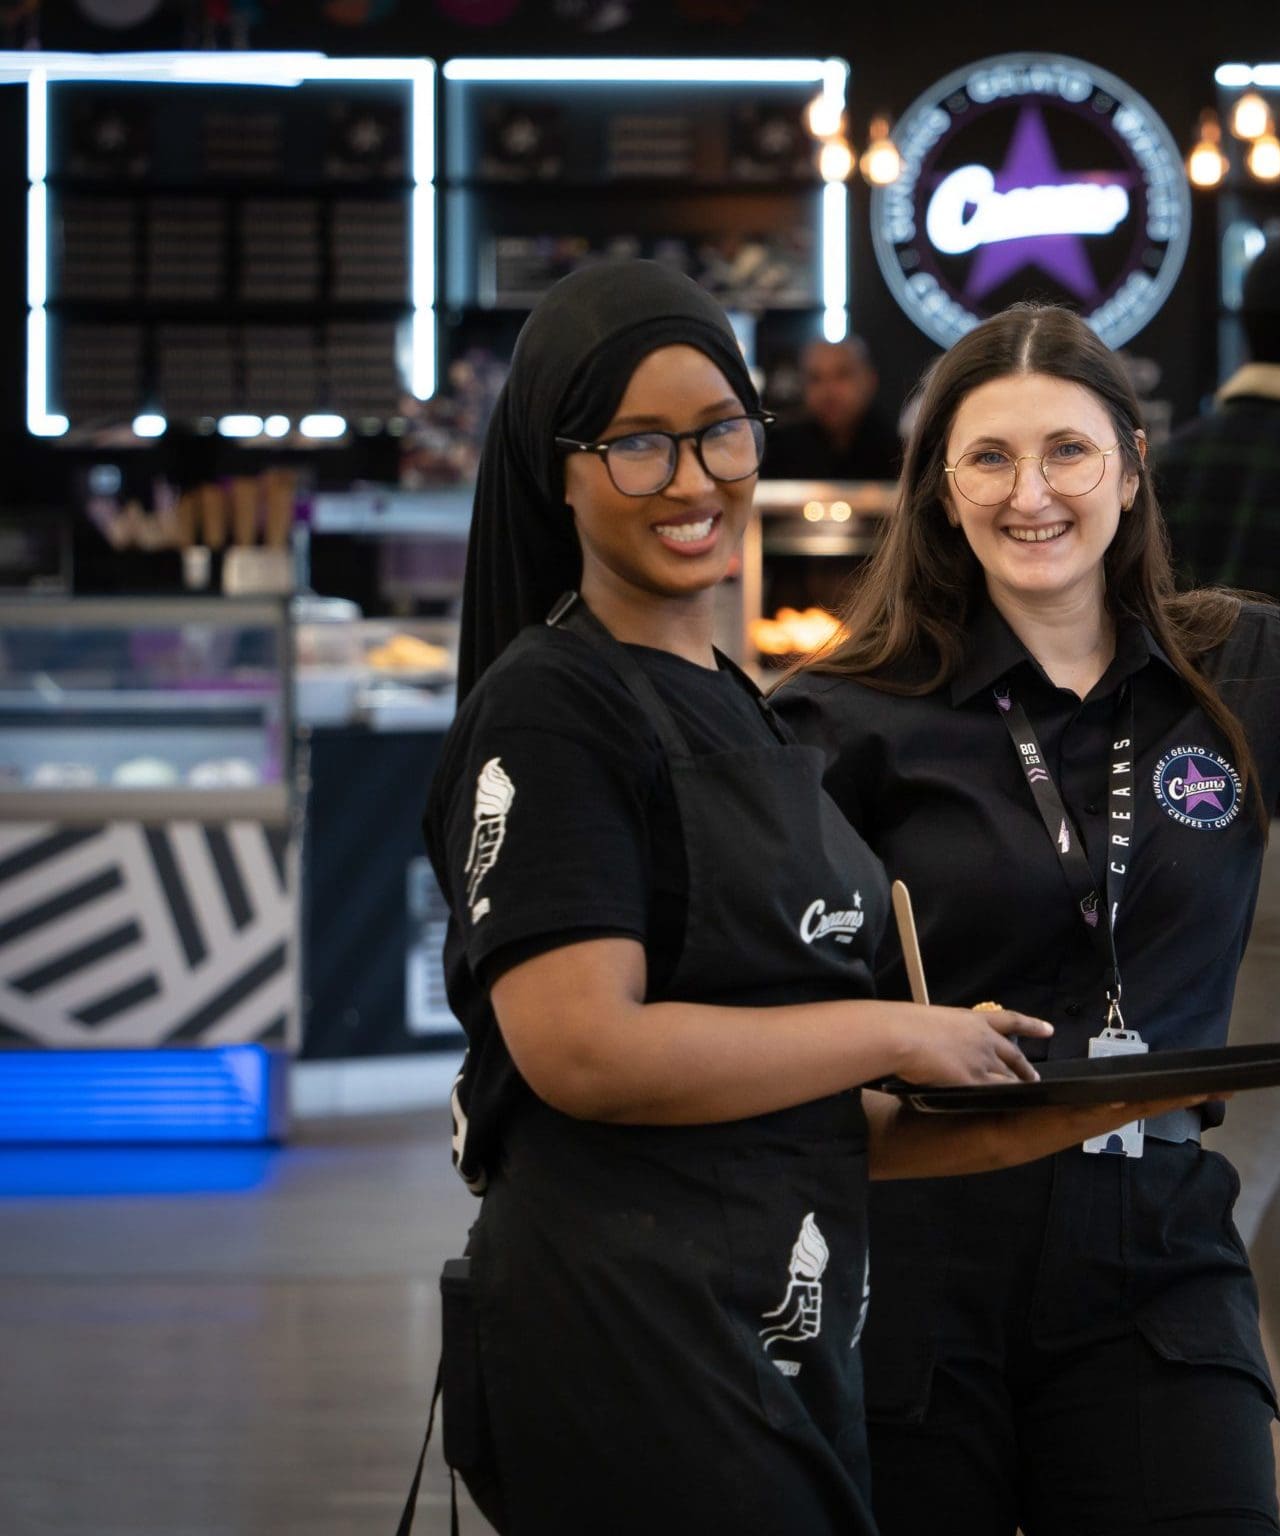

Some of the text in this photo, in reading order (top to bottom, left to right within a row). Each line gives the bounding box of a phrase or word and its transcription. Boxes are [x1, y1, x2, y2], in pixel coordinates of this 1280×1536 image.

[1168, 777, 1226, 800] Creams
[1171, 747, 1205, 757] GELATO
[1217, 756, 1242, 793] WAFFLES
[1110, 738, 1131, 875] CREAMS
[1168, 809, 1202, 828] CREPES
[800, 899, 864, 944] Creams
